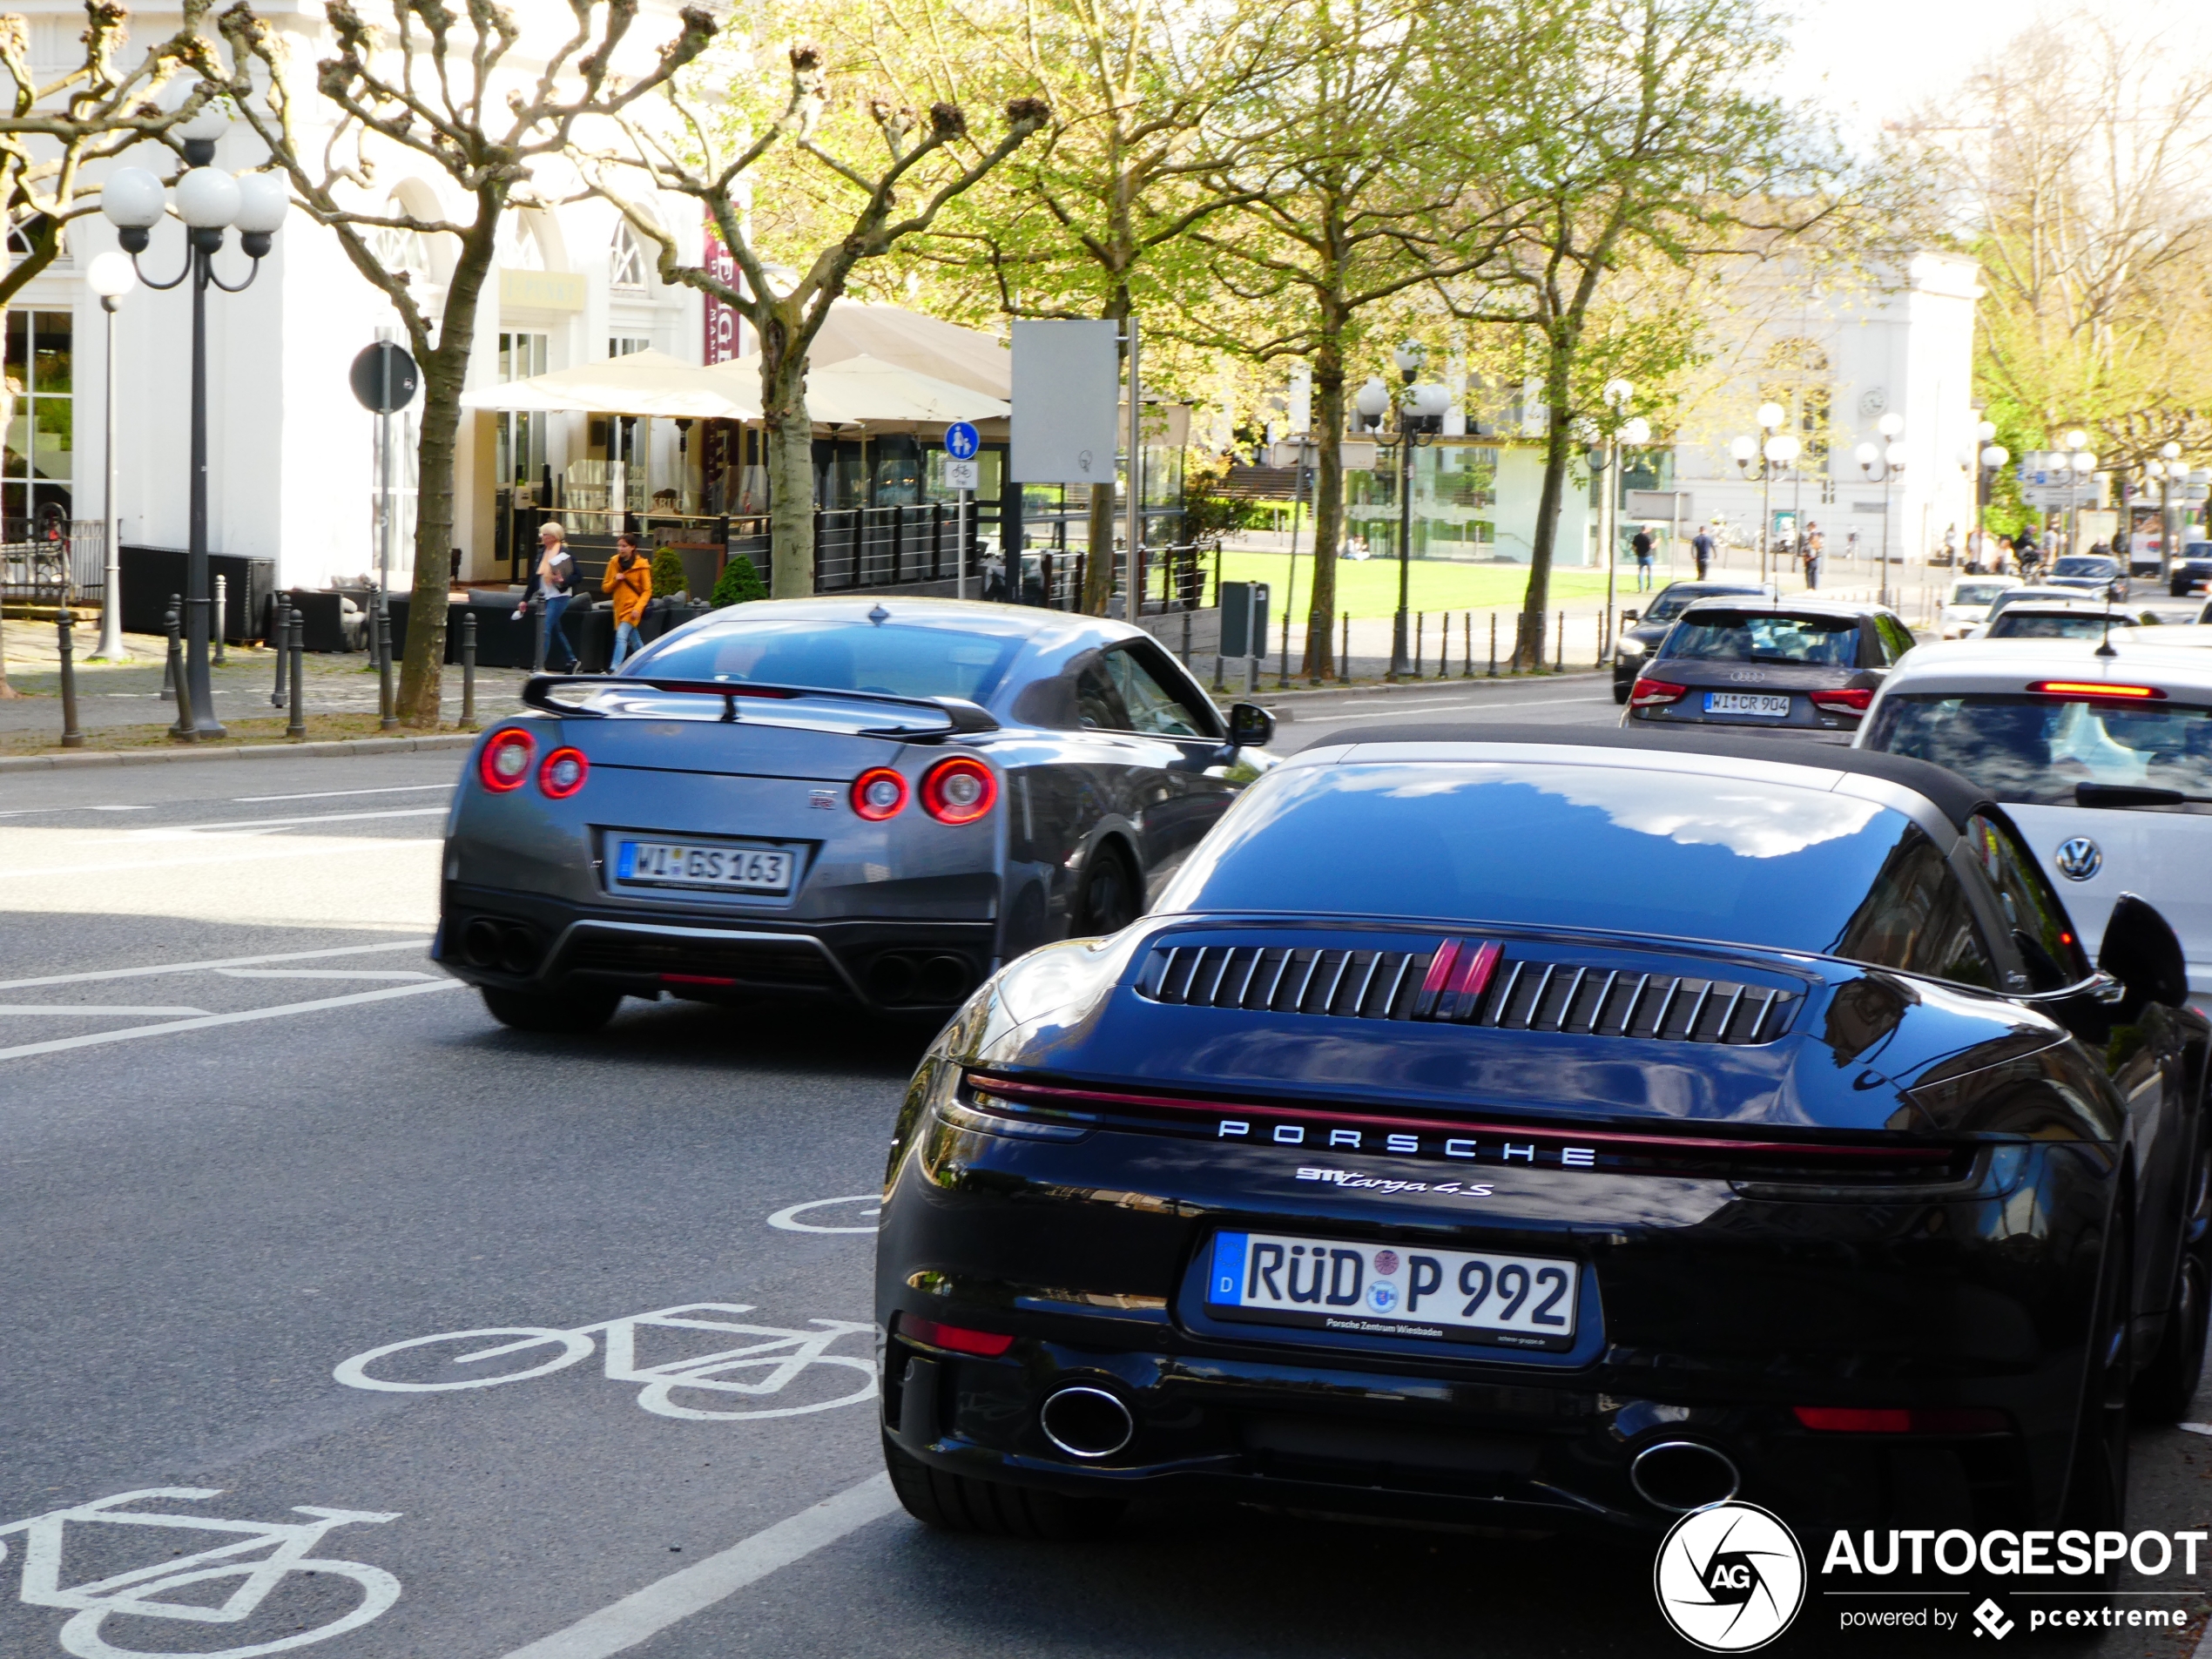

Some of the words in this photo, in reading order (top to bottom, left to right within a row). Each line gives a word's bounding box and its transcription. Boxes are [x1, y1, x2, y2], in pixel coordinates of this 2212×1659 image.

[1713, 695, 1729, 709] WI
[1739, 697, 1757, 710] CR
[1762, 698, 1787, 711] 904
[637, 847, 665, 875] WI
[1218, 1120, 1595, 1166] PORSCHE
[1219, 1277, 1233, 1292] D
[1407, 1255, 1443, 1312] P
[1458, 1261, 1567, 1326] 992
[1325, 1318, 1360, 1329] Porsche
[1360, 1321, 1396, 1332] Zentrum
[1396, 1325, 1444, 1337] Wiesbaden
